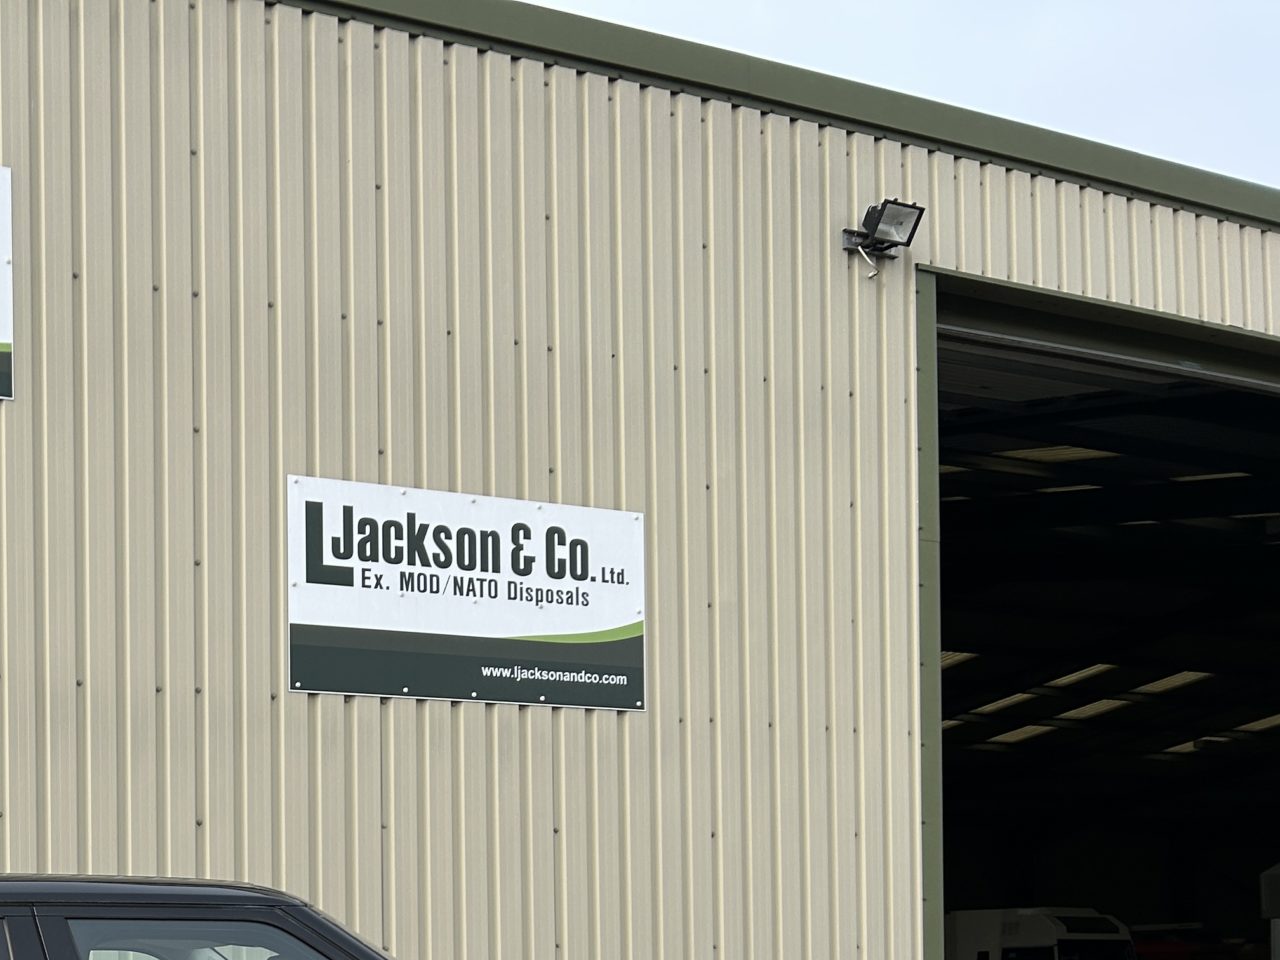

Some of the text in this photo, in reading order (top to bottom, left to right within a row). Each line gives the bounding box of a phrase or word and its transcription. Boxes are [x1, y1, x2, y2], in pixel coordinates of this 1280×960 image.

[511, 522, 536, 577] &
[545, 525, 597, 582] Co.
[601, 566, 630, 586] Ltd.
[361, 567, 590, 607] Ex. MOD/NATO Disposals
[481, 665, 628, 685] www.ljacksonandco.com
